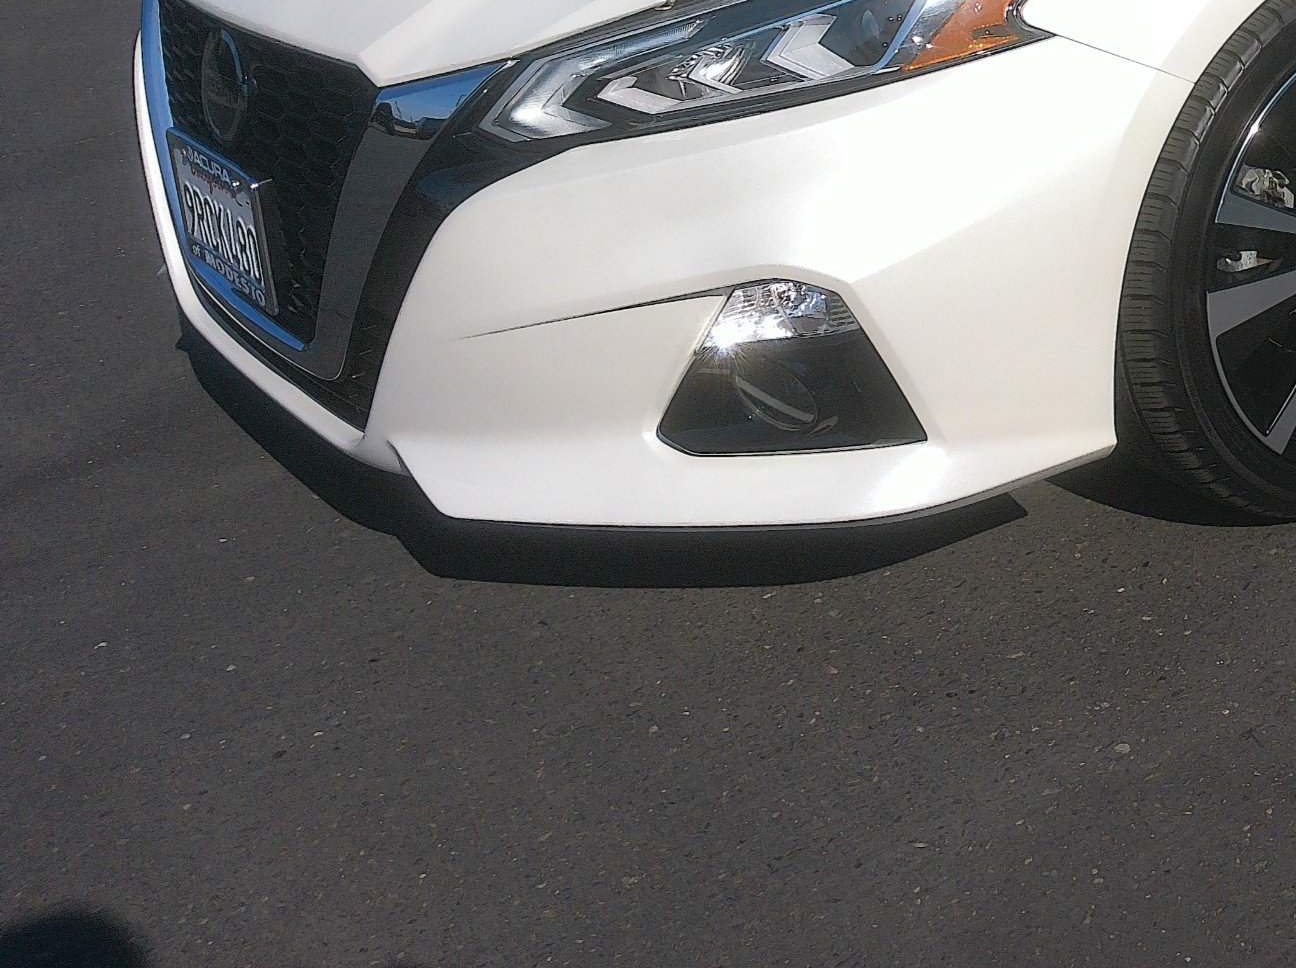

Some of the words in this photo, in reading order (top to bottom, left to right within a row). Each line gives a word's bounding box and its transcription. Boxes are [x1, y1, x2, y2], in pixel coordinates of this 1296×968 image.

[193, 150, 231, 182] ACURA
[192, 244, 200, 257] of
[204, 248, 266, 307] MODESTO
